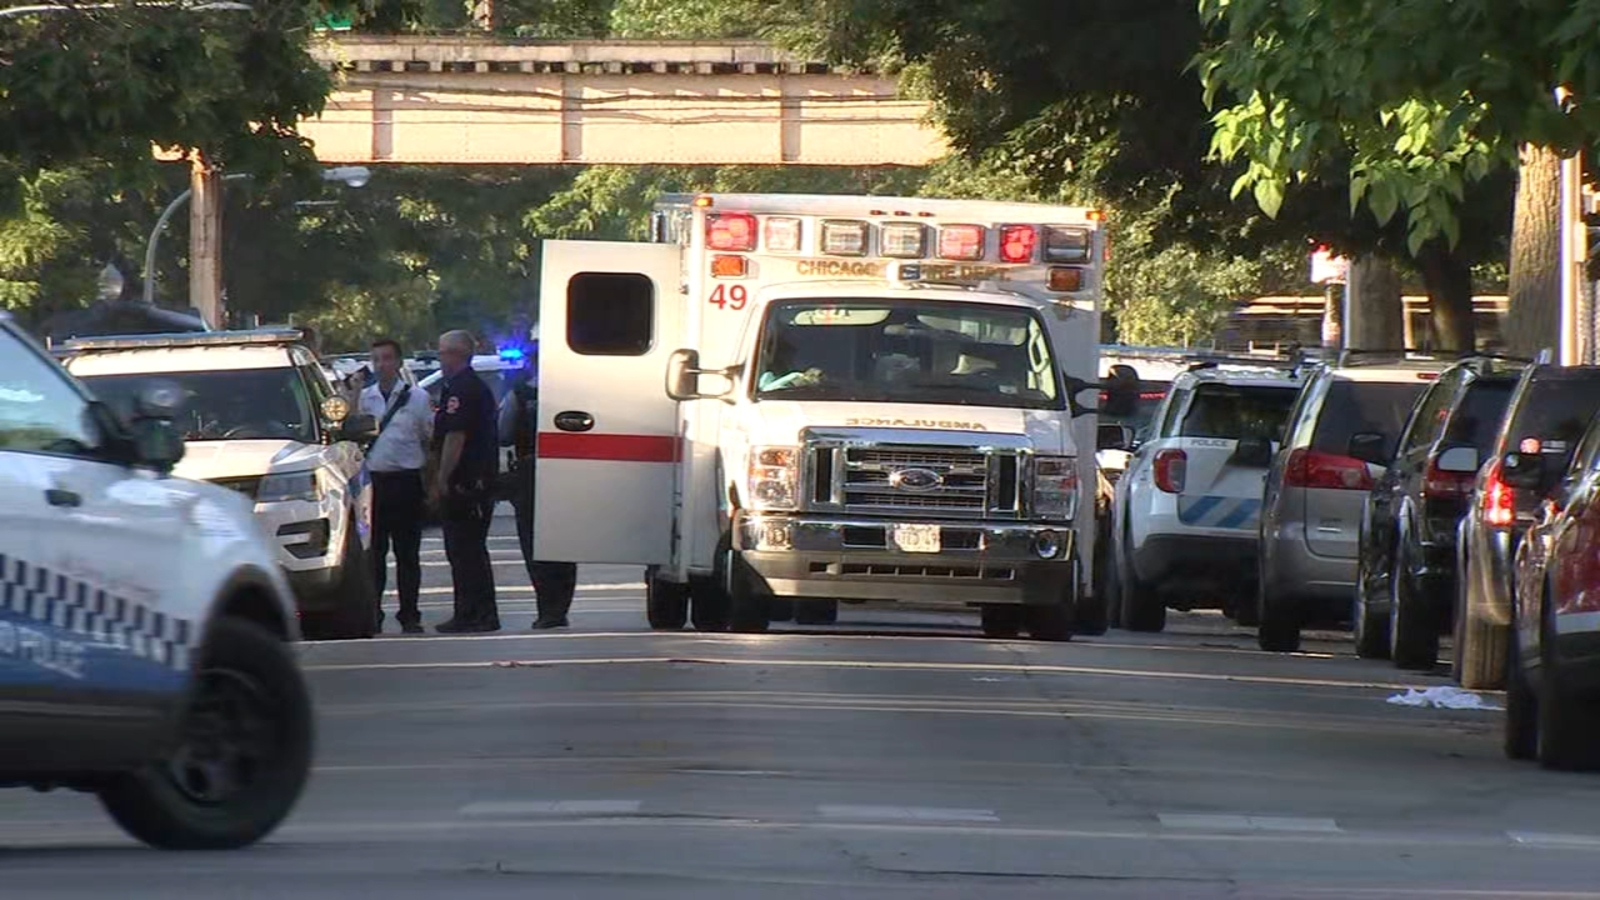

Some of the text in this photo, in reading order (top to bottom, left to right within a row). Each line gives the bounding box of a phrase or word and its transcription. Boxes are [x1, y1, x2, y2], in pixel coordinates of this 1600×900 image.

[797, 260, 881, 277] CHICAGO
[708, 283, 748, 311] 49
[1190, 439, 1228, 447] POLICE
